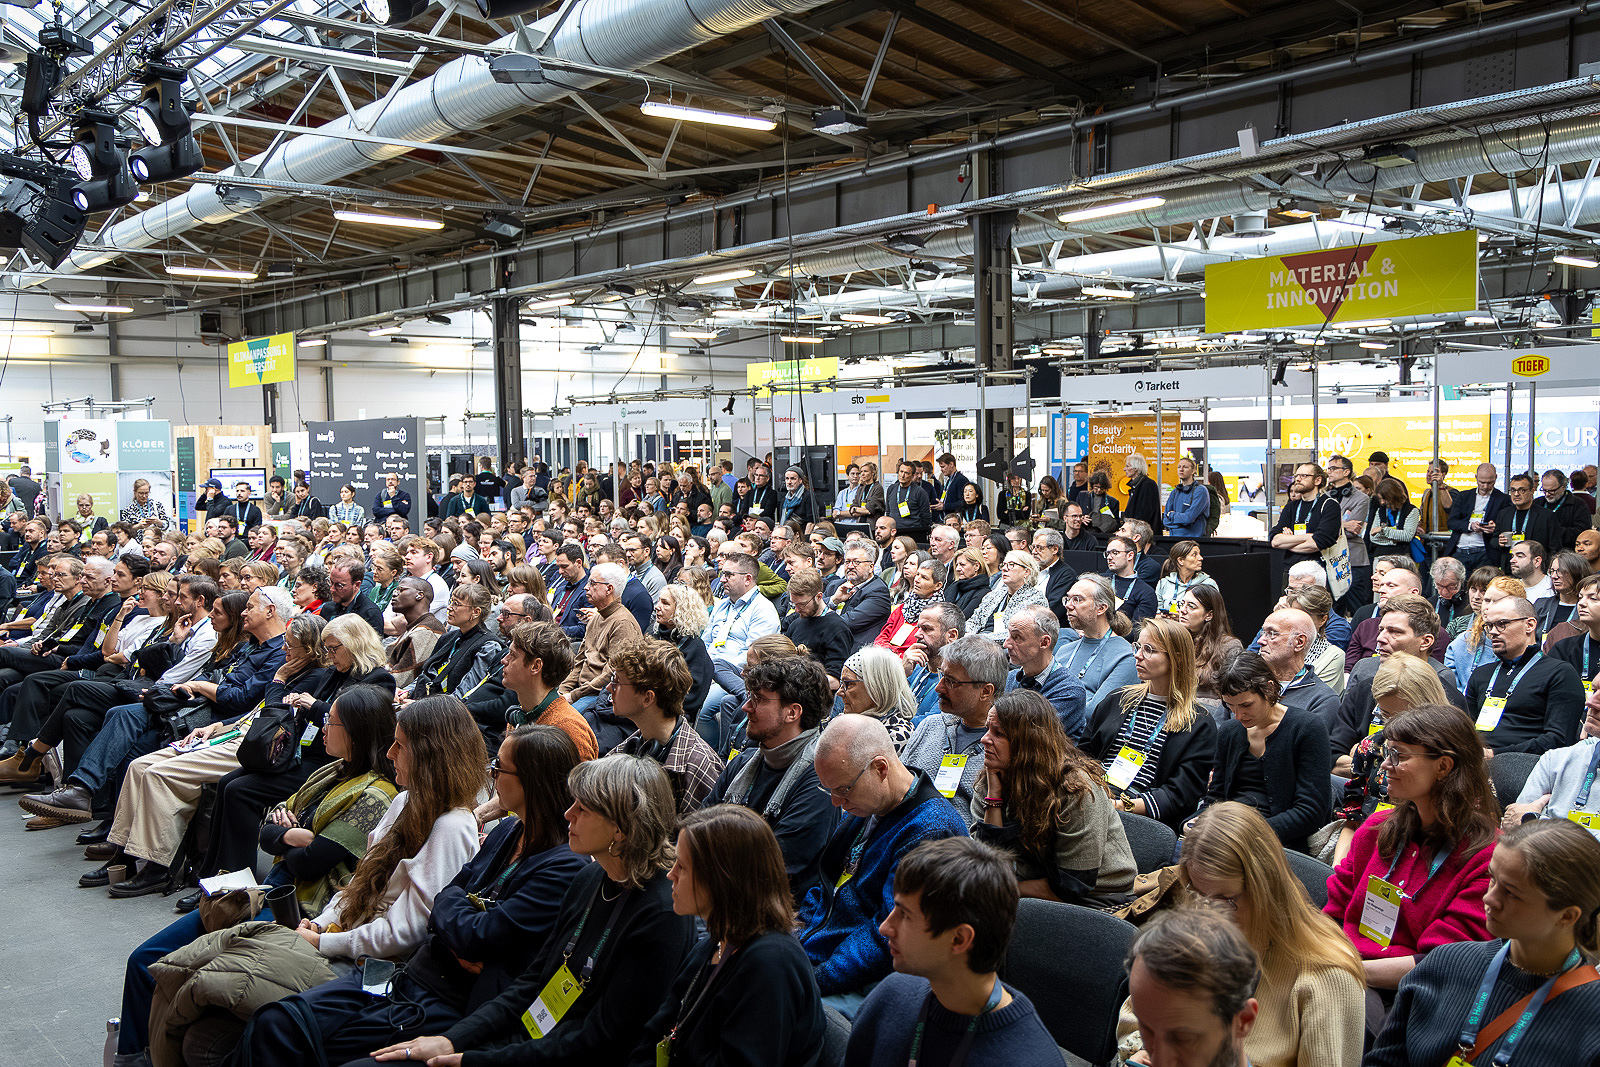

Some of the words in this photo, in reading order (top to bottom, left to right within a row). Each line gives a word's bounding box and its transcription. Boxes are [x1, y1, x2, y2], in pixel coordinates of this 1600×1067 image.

[1269, 259, 1373, 288] MATERIAL
[1380, 257, 1396, 276] &
[1266, 279, 1399, 310] INNOVATION
[1517, 359, 1544, 373] TIGER
[1145, 380, 1180, 391] Tarkett
[851, 394, 864, 405] sto
[1092, 424, 1122, 436] Beauty
[122, 439, 165, 449] KLÖBER
[1105, 434, 1115, 445] of
[1092, 443, 1137, 456] Circularity
[1472, 991, 1489, 1016] Heinze
[1507, 1019, 1528, 1044] Heinze
